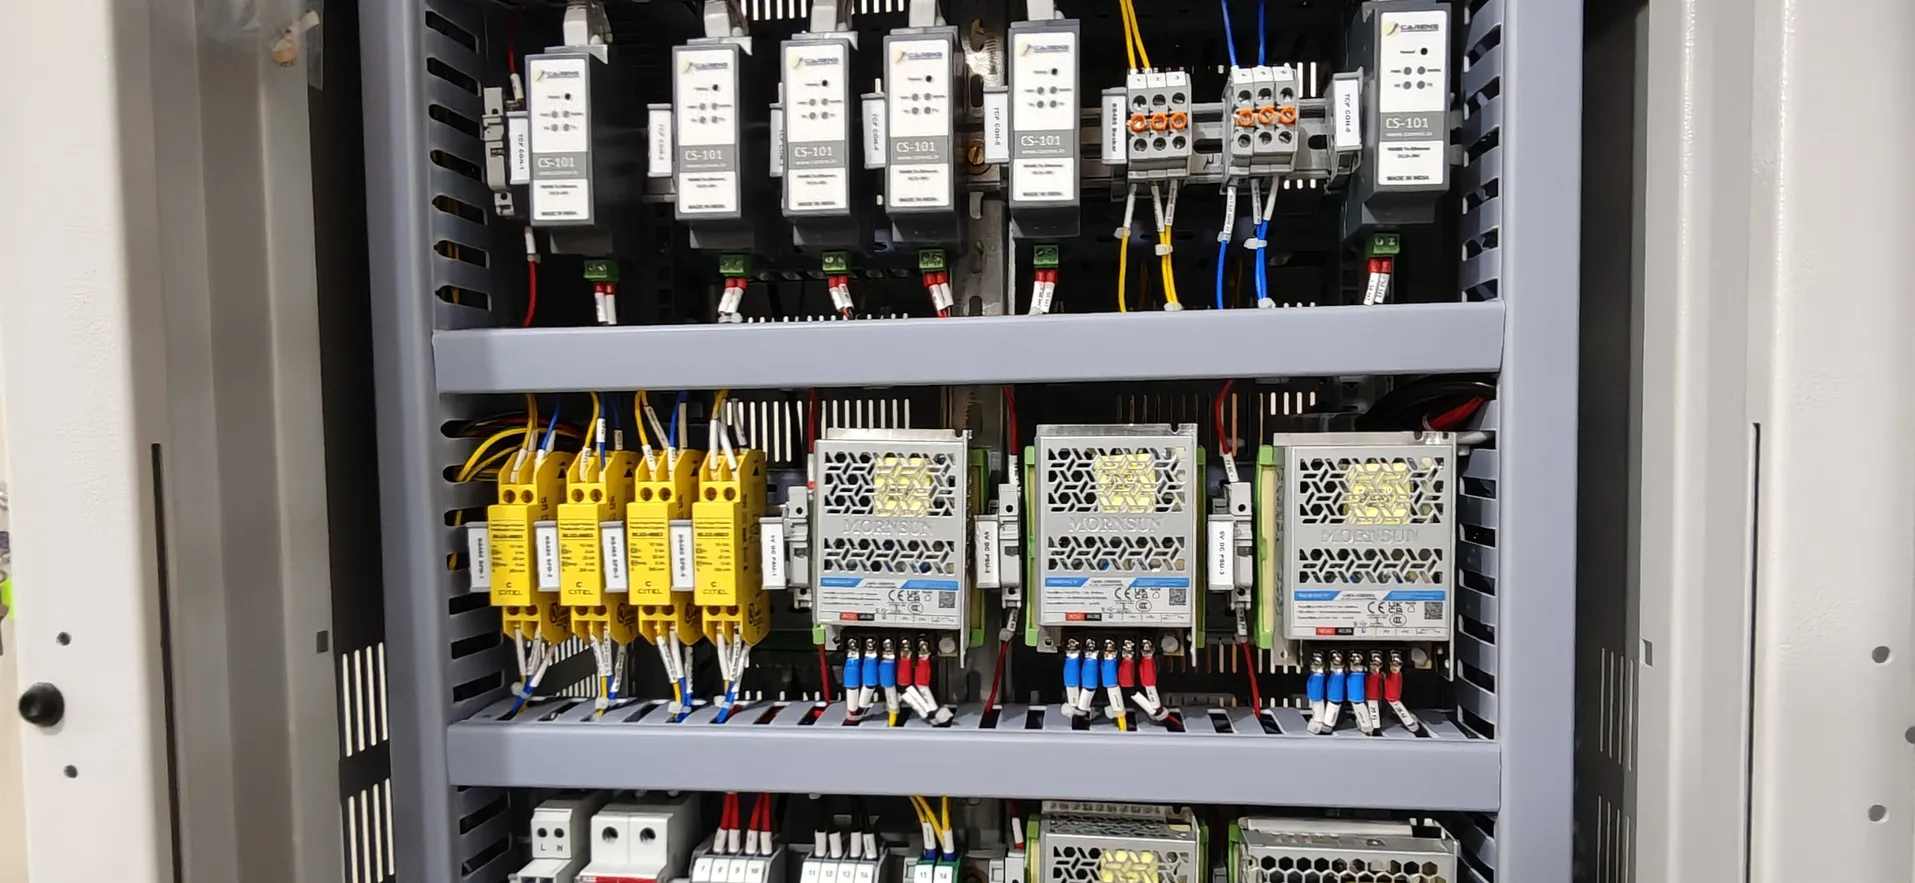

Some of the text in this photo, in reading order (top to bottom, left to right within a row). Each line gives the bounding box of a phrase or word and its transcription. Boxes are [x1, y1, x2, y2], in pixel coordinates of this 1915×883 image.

[1385, 117, 1429, 129] CS-101
[1021, 135, 1061, 146] CS-101
[794, 146, 833, 157] CS-101
[896, 141, 936, 152] CS-101
[685, 150, 723, 160] CS-101
[538, 157, 575, 168] CS-101
[1068, 516, 1164, 533] MORNSUN
[1320, 528, 1420, 544] MORNSUN
[556, 844, 563, 852] N
